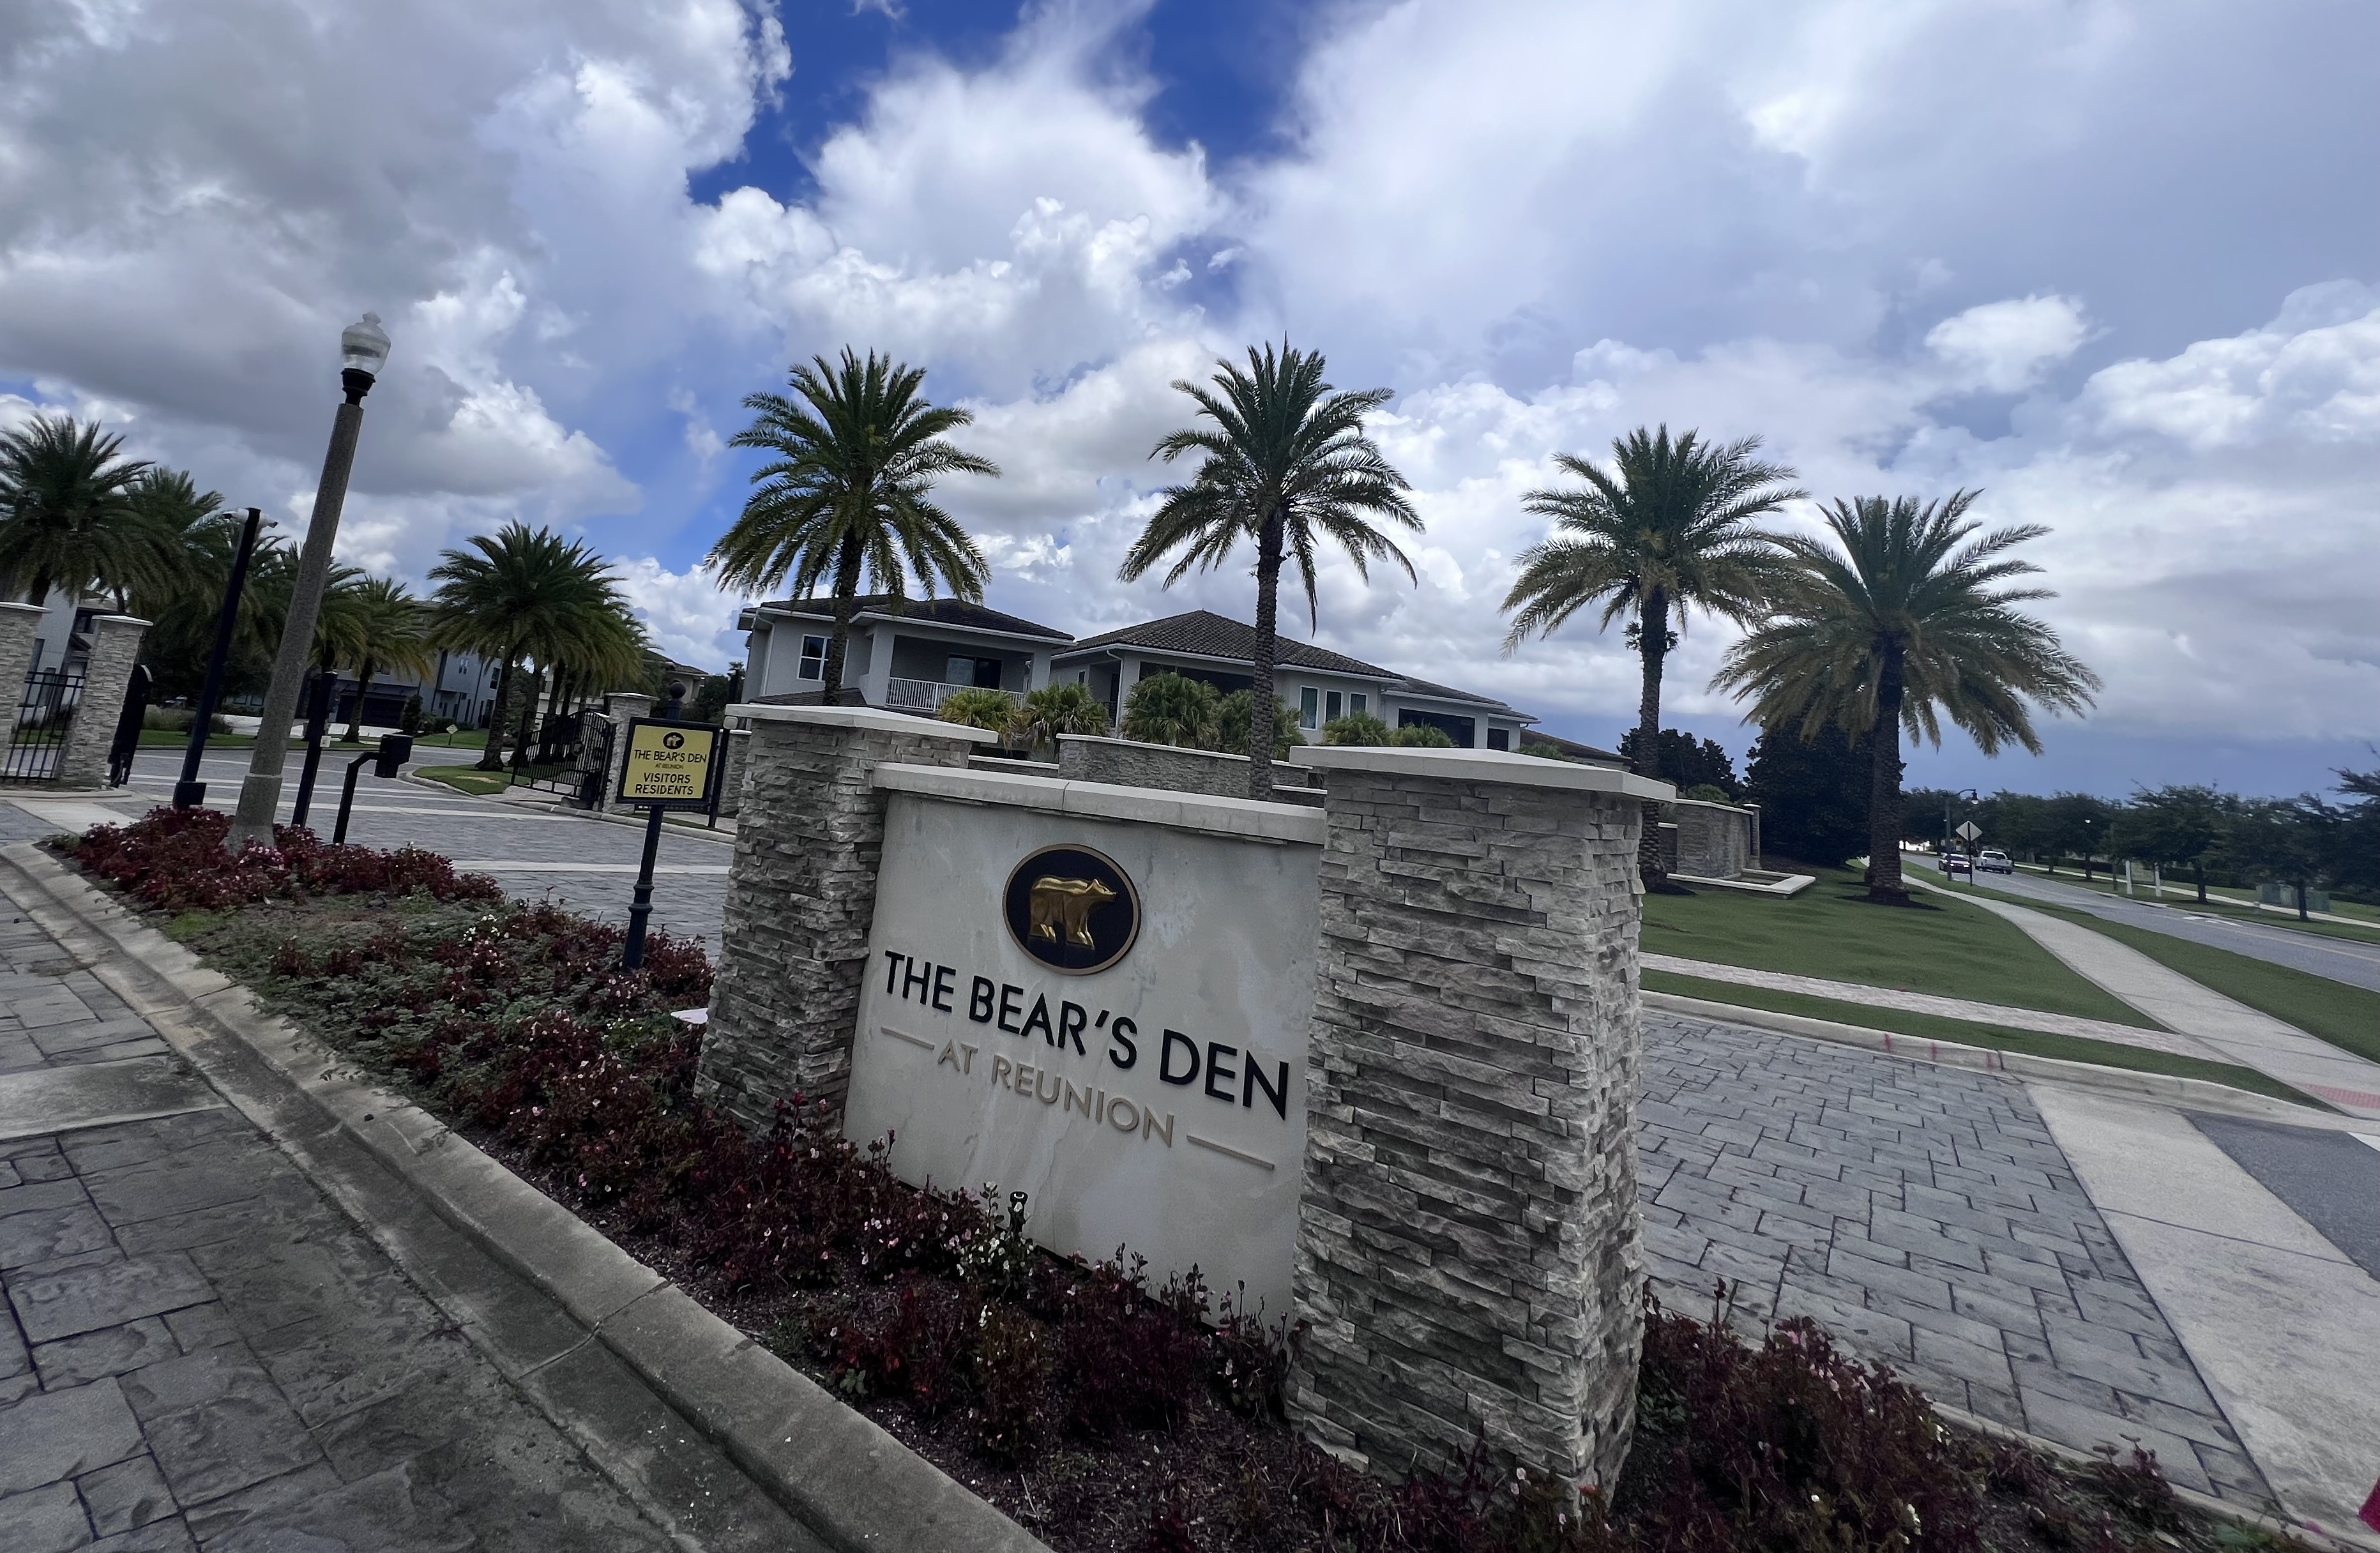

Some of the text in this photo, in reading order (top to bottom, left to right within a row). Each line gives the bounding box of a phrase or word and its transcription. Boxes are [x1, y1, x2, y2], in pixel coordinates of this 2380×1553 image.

[634, 749, 707, 762] THE BEAR'S DEN
[644, 773, 691, 784] VISITORS
[635, 784, 694, 795] RESIDENTS
[884, 950, 1289, 1121] THE BEAR'S DEN
[937, 1039, 1174, 1148] AT REUNION
